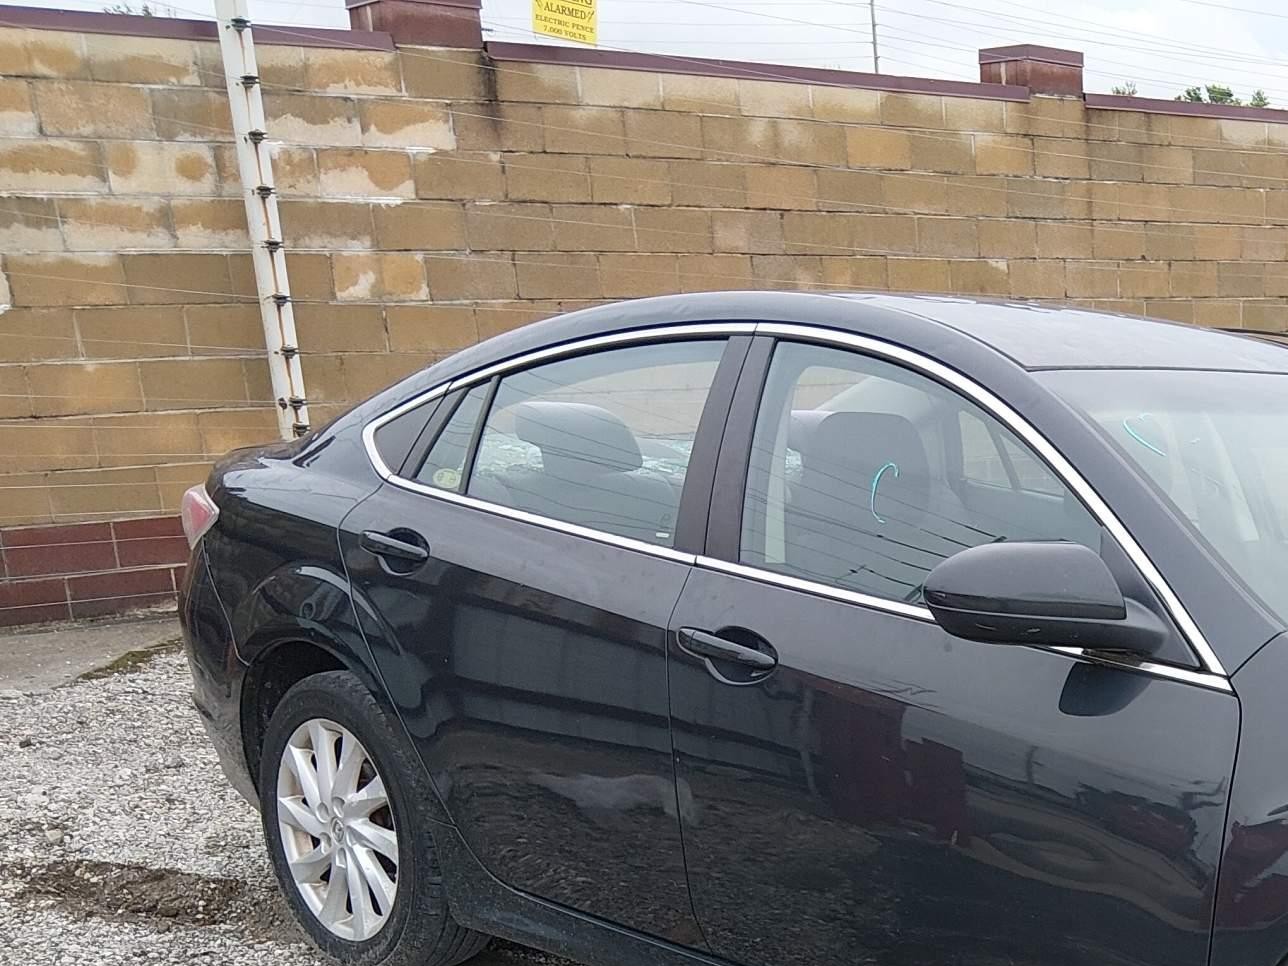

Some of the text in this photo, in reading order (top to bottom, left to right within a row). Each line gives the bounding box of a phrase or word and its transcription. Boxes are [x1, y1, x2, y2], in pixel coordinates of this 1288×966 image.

[544, 2, 586, 19] ALARMED
[535, 14, 595, 33] ELECTRIC FENCE
[563, 30, 587, 40] VOLTS
